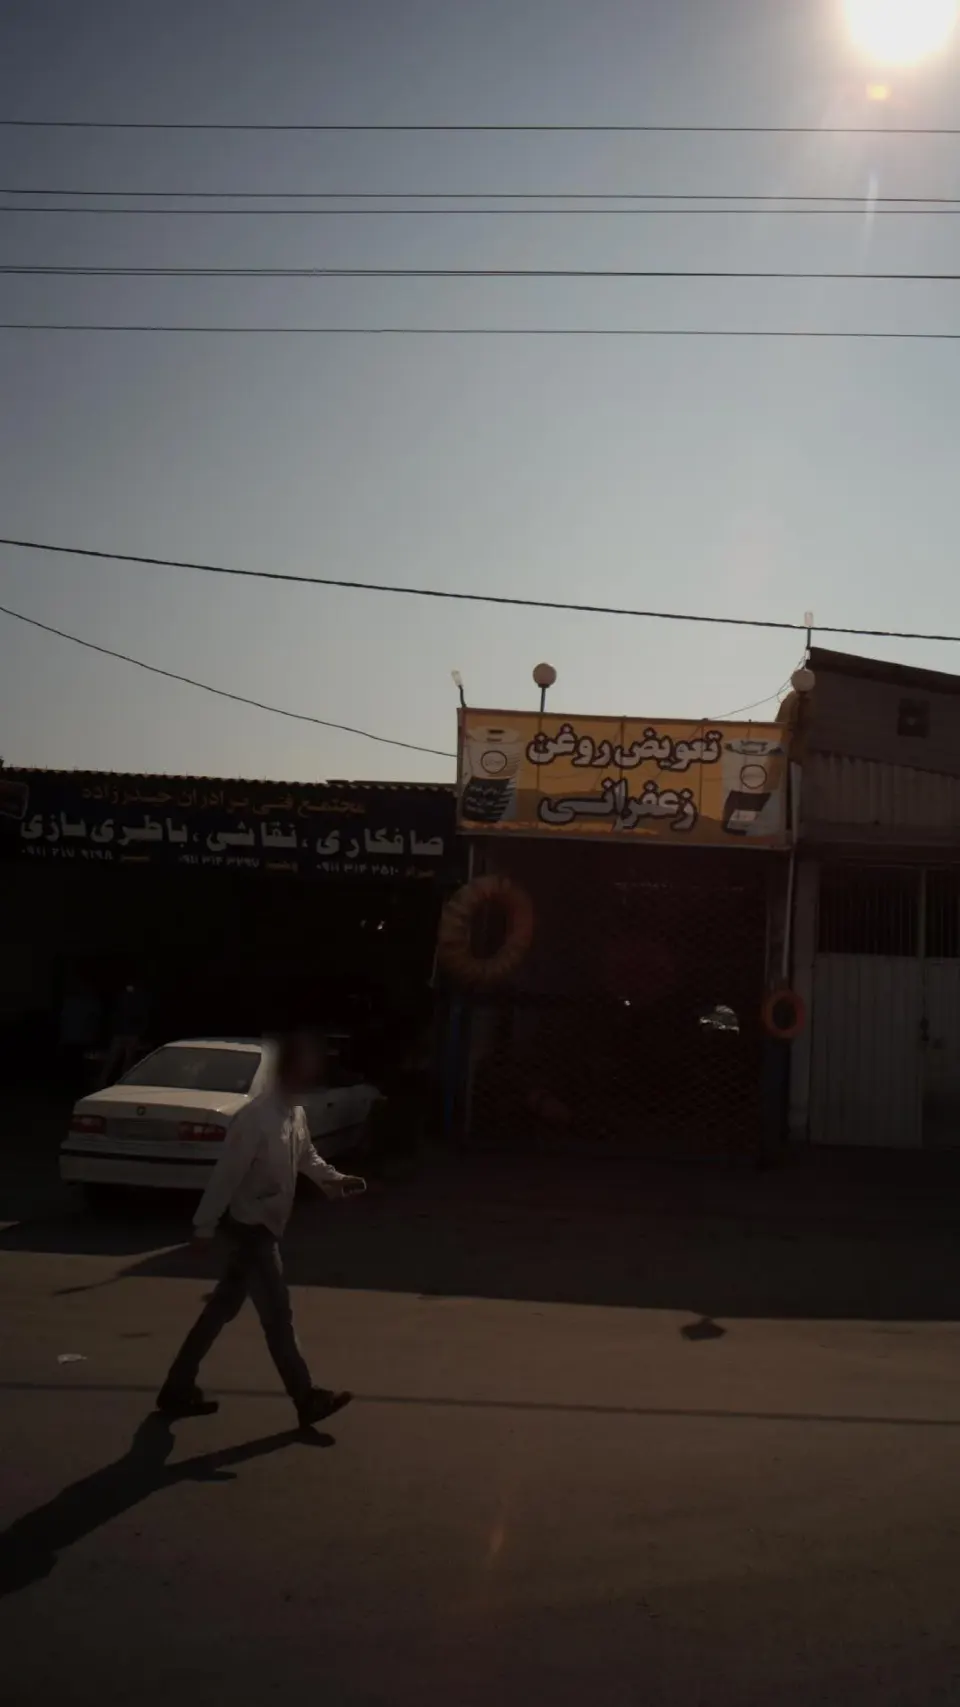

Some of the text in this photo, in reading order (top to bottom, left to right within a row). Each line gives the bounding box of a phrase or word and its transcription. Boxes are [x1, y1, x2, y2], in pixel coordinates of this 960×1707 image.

[526, 723, 723, 772] تعویض روغن
[297, 798, 366, 819] مجتمع
[538, 777, 698, 830] زعفرانی
